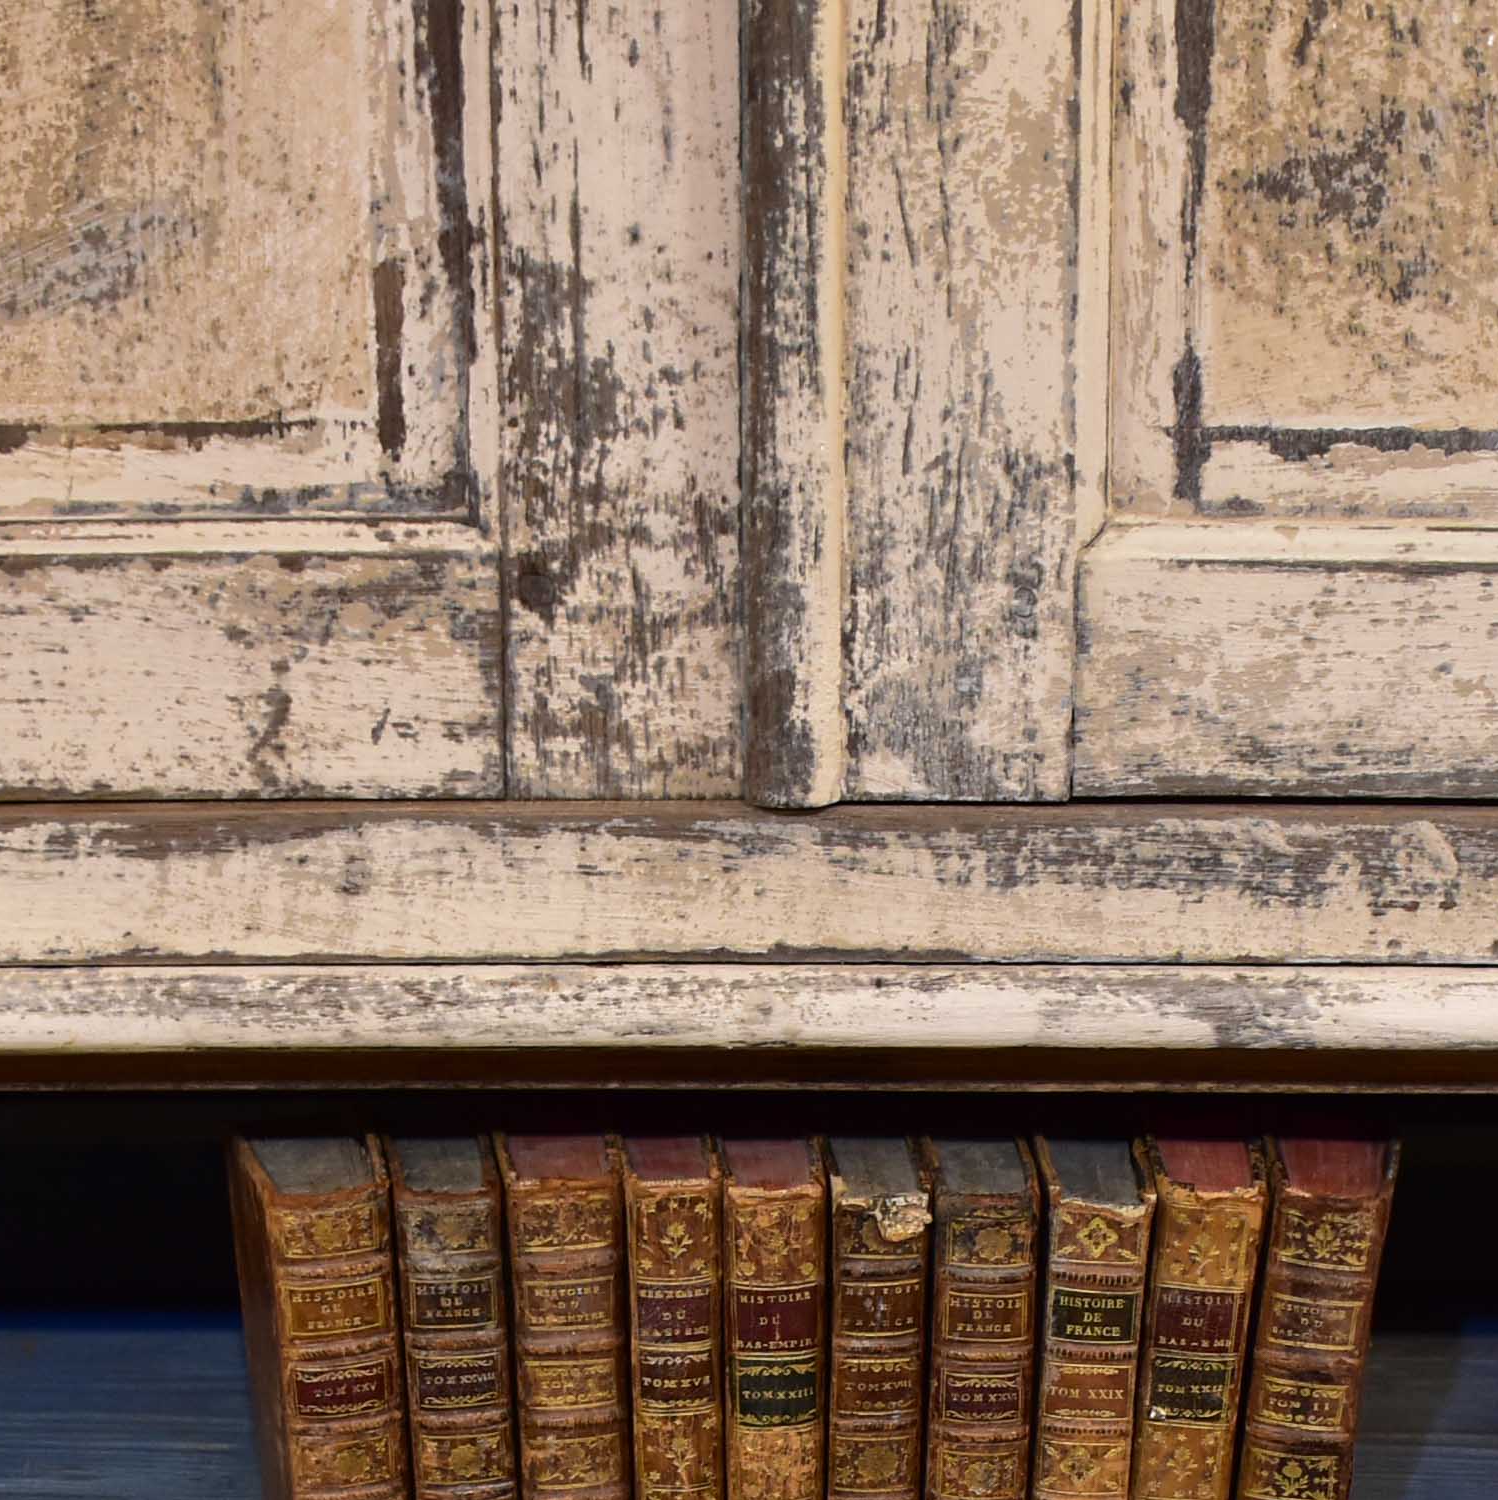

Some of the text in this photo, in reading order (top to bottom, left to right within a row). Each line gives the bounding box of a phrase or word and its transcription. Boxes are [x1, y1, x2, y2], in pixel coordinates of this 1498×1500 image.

[740, 1291, 811, 1304] HISTOIRE
[1060, 1295, 1125, 1309] HISTOIRE
[662, 1310, 686, 1321] DU
[759, 1313, 781, 1325] DU
[973, 1310, 994, 1319] DE
[1083, 1312, 1102, 1322] DE
[1181, 1317, 1204, 1327] DU
[957, 1323, 1012, 1333] FRANCE
[1066, 1325, 1121, 1337] FRANCE
[1049, 1386, 1124, 1400] TOM XXIX
[1157, 1384, 1185, 1393] TOM
[952, 1392, 983, 1401] TOM
